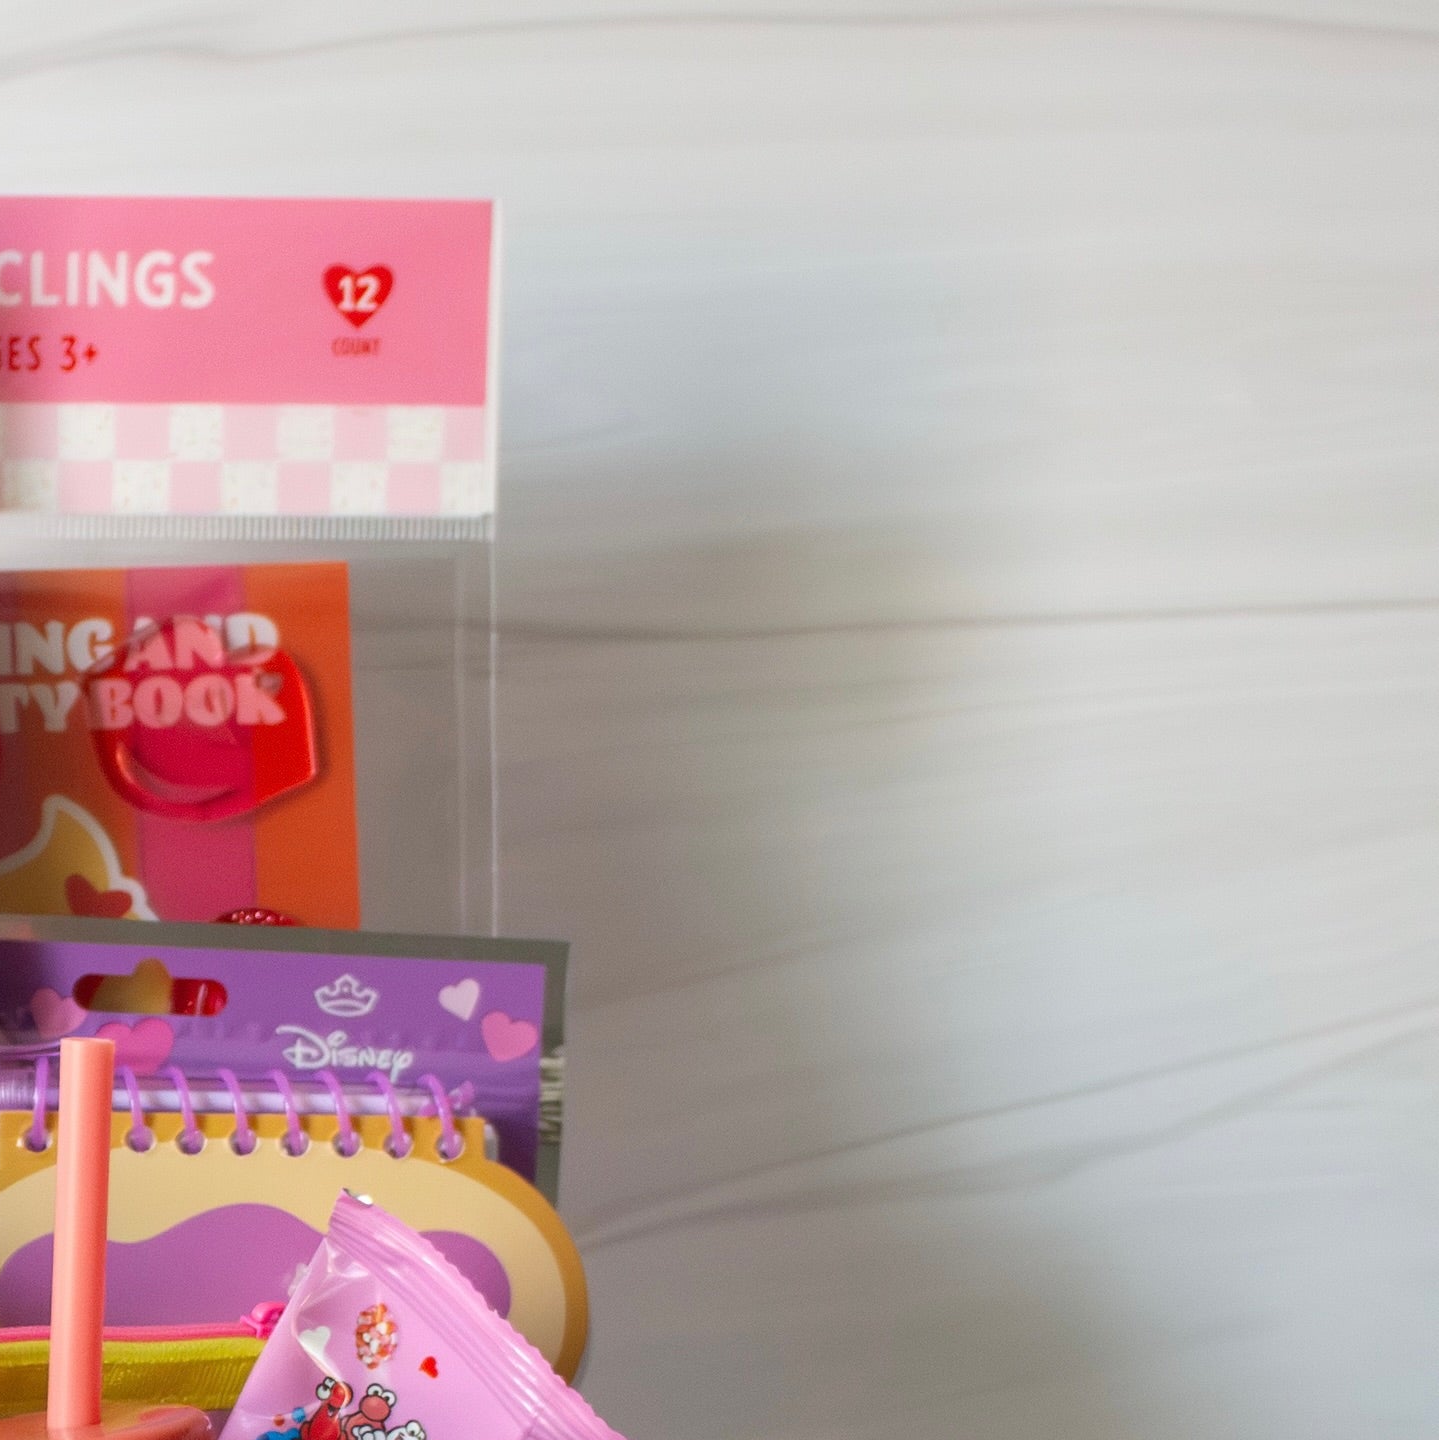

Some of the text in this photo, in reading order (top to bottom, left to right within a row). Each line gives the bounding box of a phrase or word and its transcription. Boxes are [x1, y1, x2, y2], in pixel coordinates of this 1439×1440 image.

[338, 275, 380, 312] 12
[60, 335, 98, 372] 3+
[124, 612, 278, 672] AND
[94, 670, 287, 731] BOOK
[276, 1025, 413, 1084] Disney
